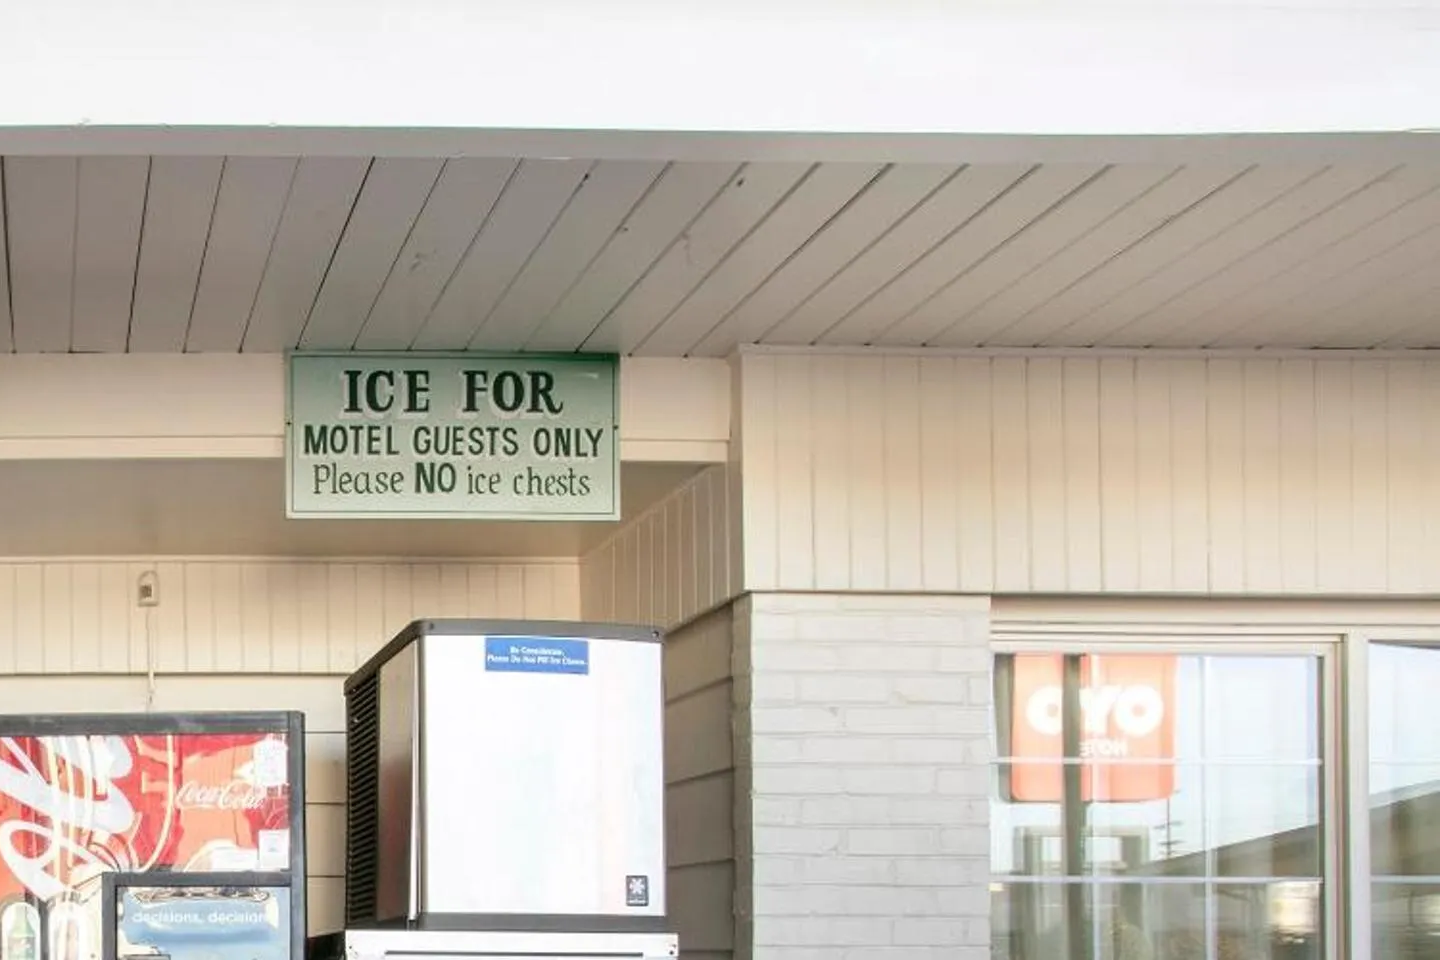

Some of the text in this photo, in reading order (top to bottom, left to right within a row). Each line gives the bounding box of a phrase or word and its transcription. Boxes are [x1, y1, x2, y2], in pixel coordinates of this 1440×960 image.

[344, 369, 563, 415] ICE FOR
[304, 425, 604, 458] MOTEL GUESTS ONLY
[313, 462, 591, 496] Please NO ice chests
[208, 911, 272, 923] decision
